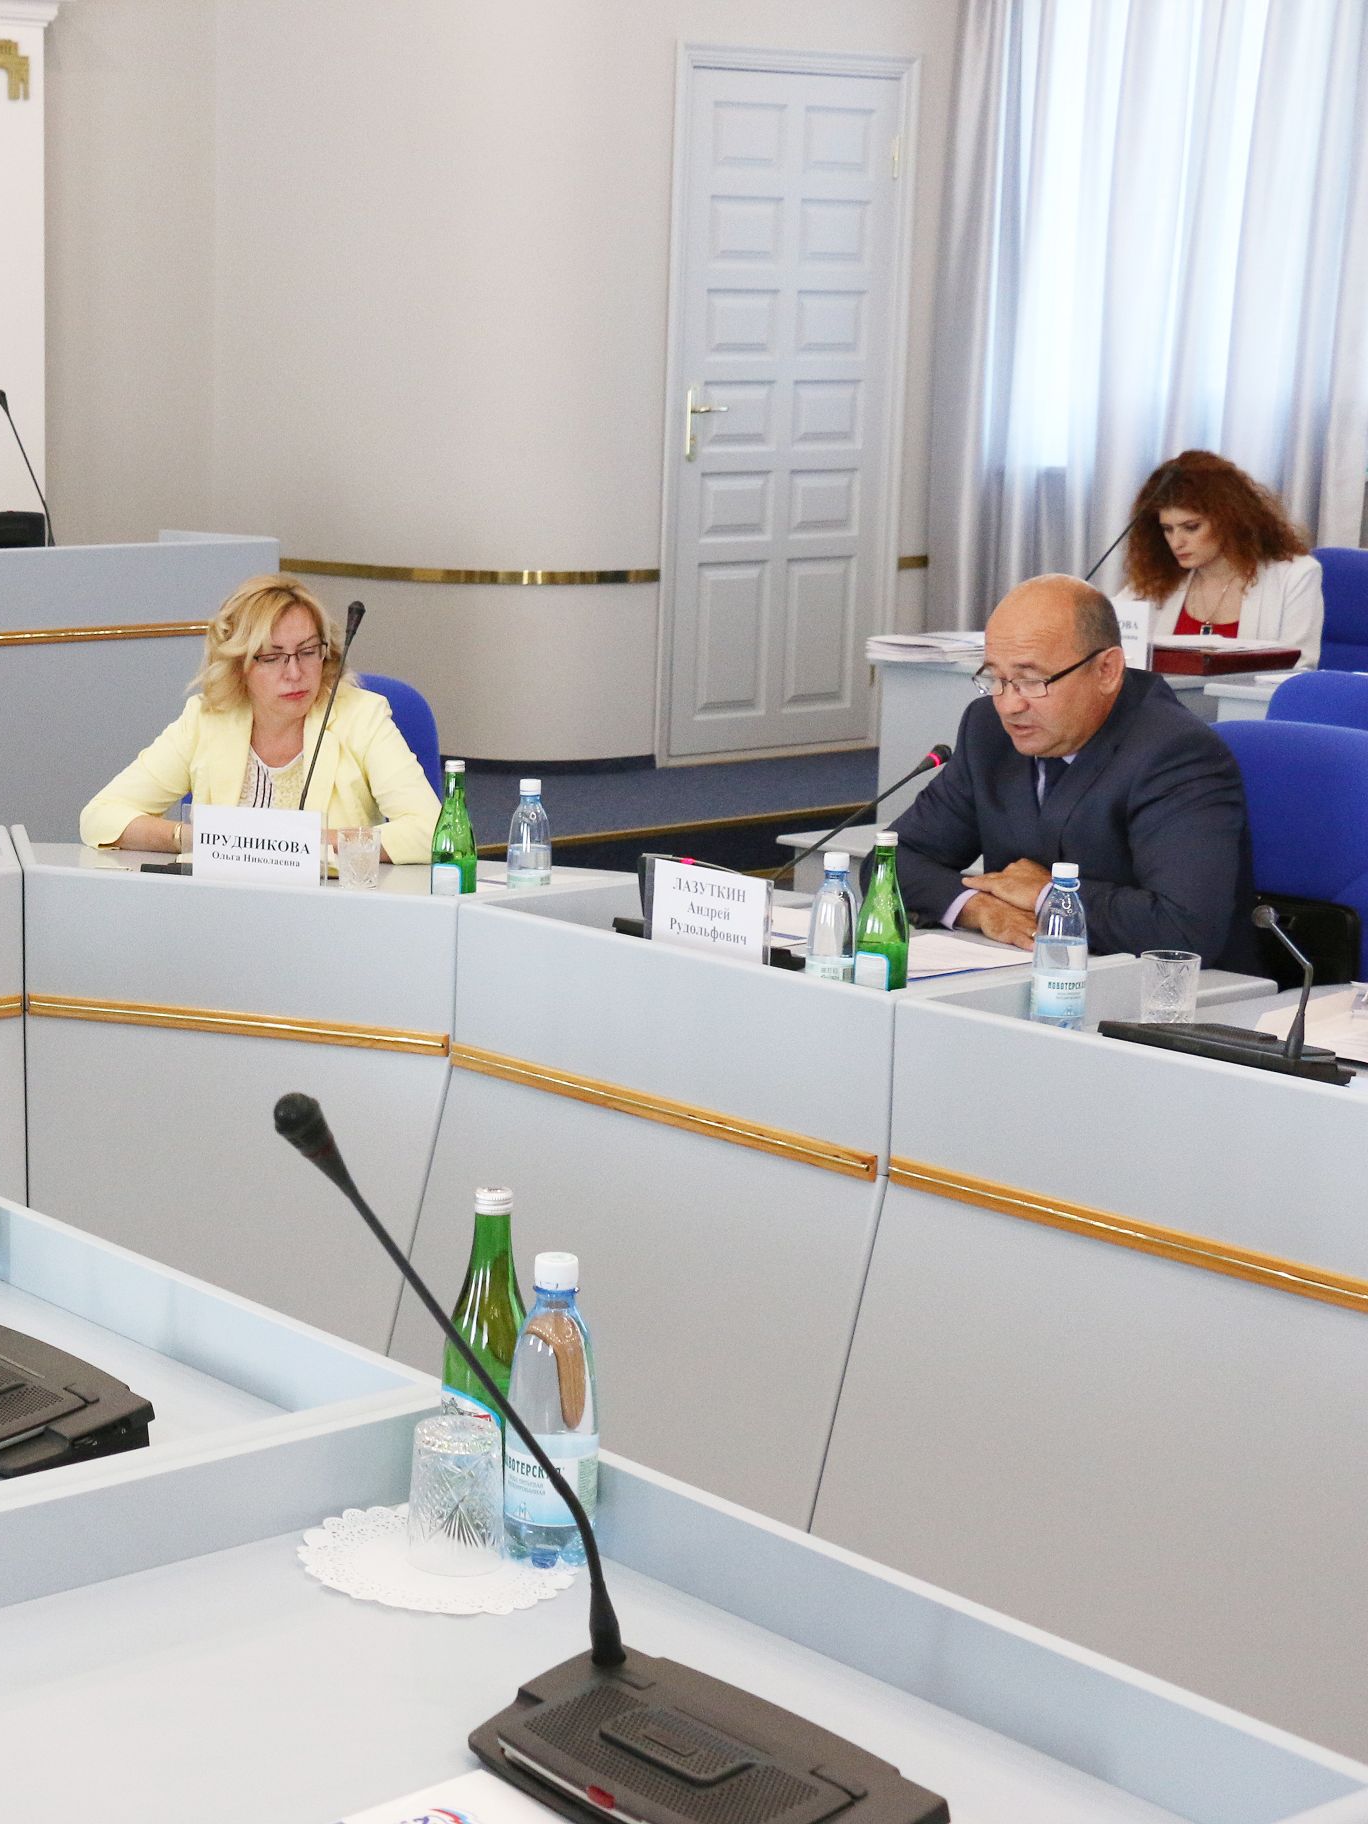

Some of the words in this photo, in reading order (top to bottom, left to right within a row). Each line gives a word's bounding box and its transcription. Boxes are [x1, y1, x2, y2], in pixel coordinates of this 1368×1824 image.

[200, 832, 310, 855] ПРУДНИКОВА
[212, 851, 241, 862] Ольга
[244, 854, 300, 868] Николаевна
[673, 877, 746, 903] ЛАЗУТКИН
[687, 901, 730, 921] Андрей
[670, 917, 747, 945] Рудольфович
